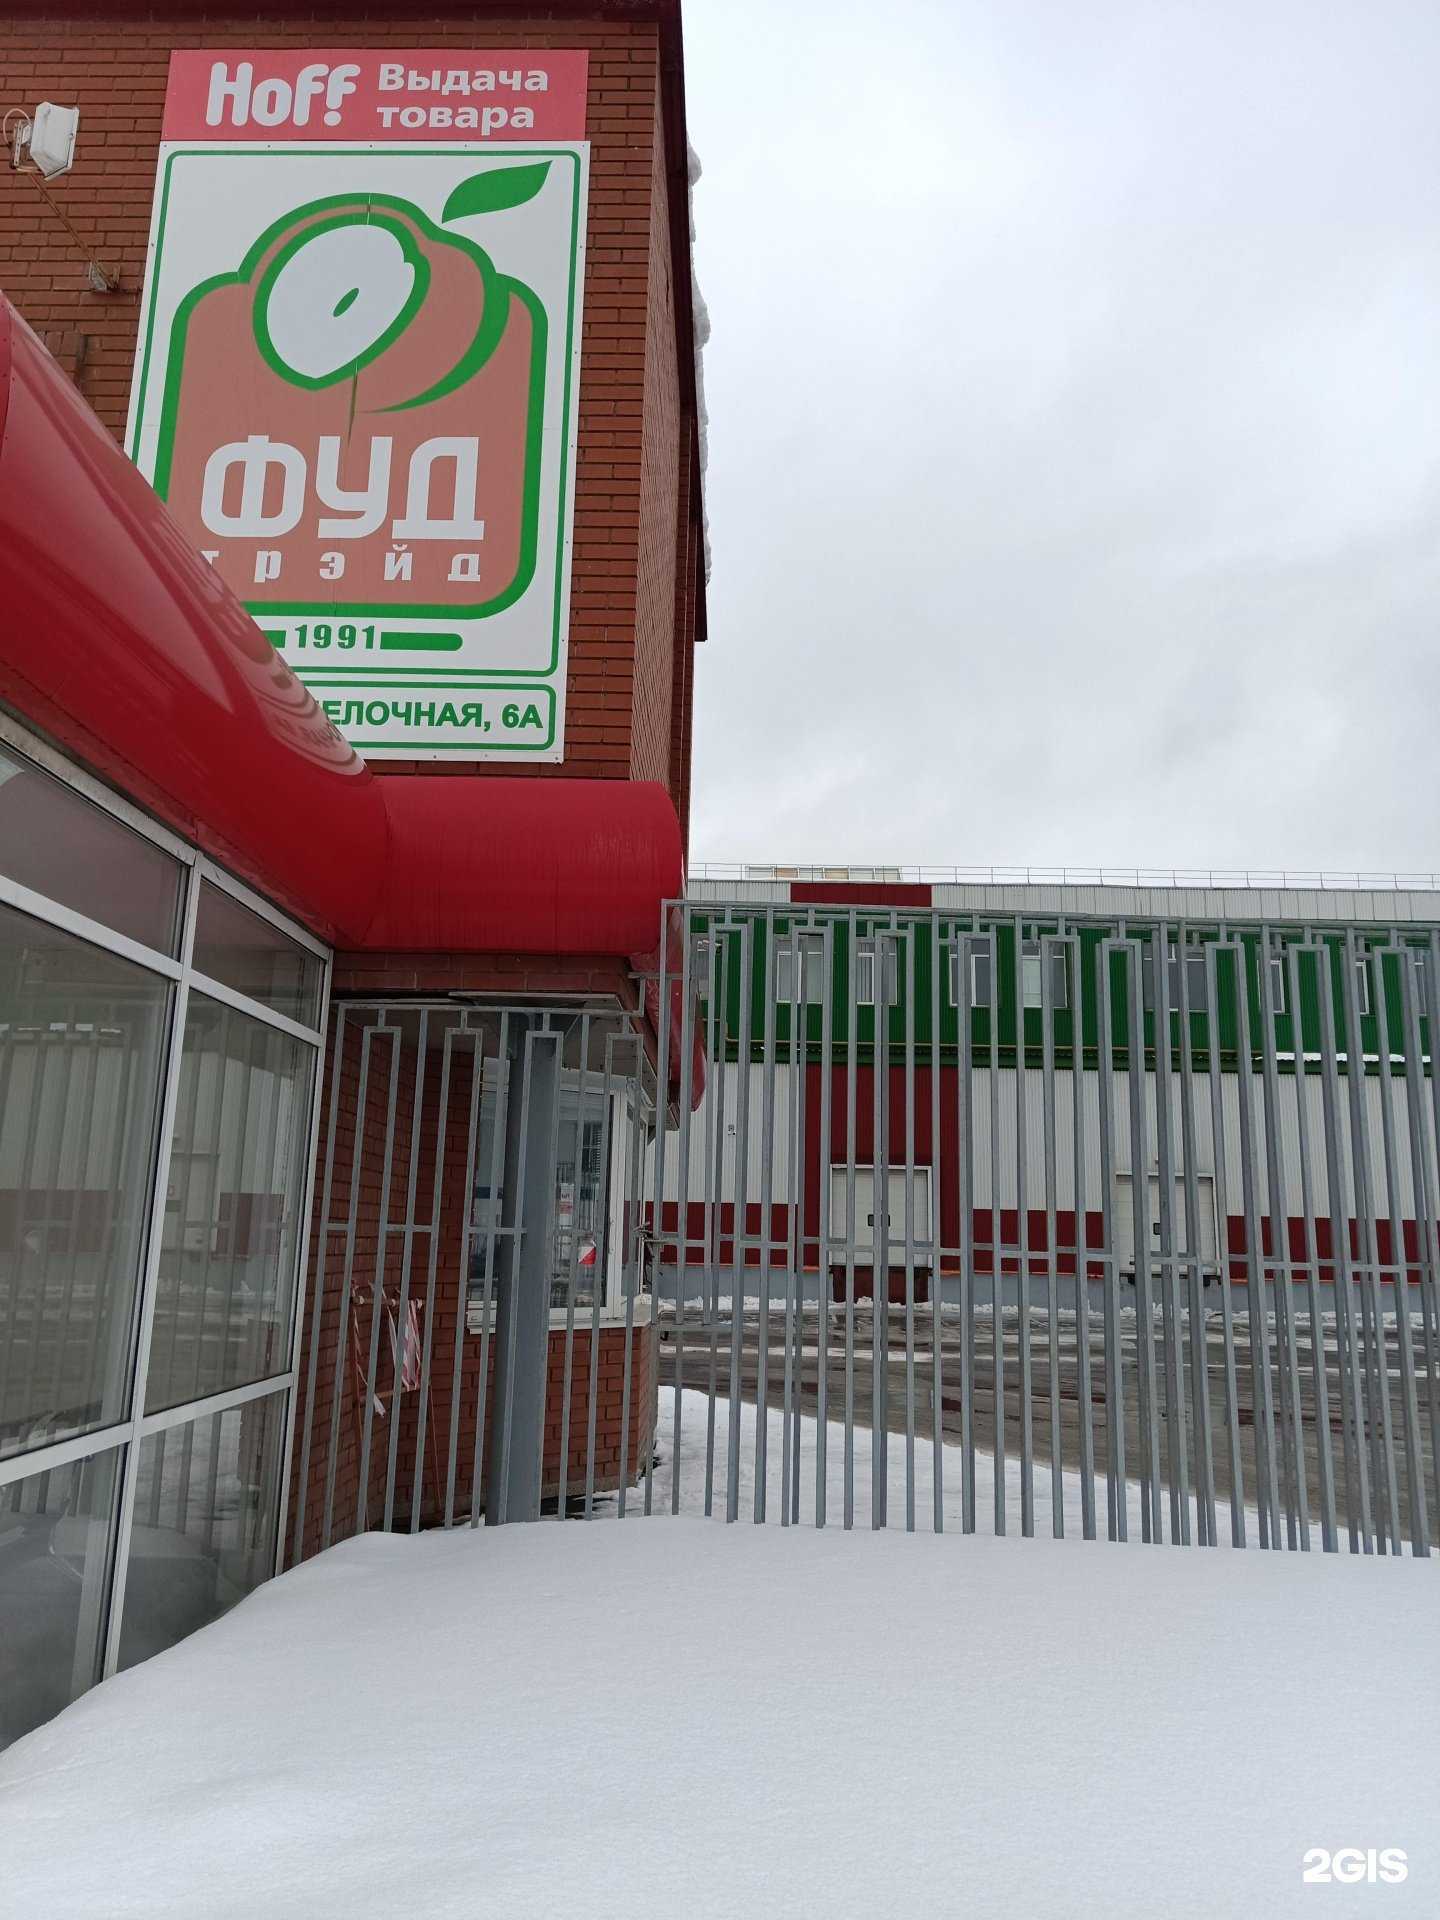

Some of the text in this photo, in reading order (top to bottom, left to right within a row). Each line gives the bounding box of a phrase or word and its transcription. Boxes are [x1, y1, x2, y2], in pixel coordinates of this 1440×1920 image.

[378, 63, 549, 96] Выдача
[377, 105, 535, 136] товара
[200, 435, 485, 541] ФУД
[294, 624, 377, 650] 1991
[314, 700, 491, 732] ЕЛОЧНАЯ,
[501, 702, 544, 729] 6А
